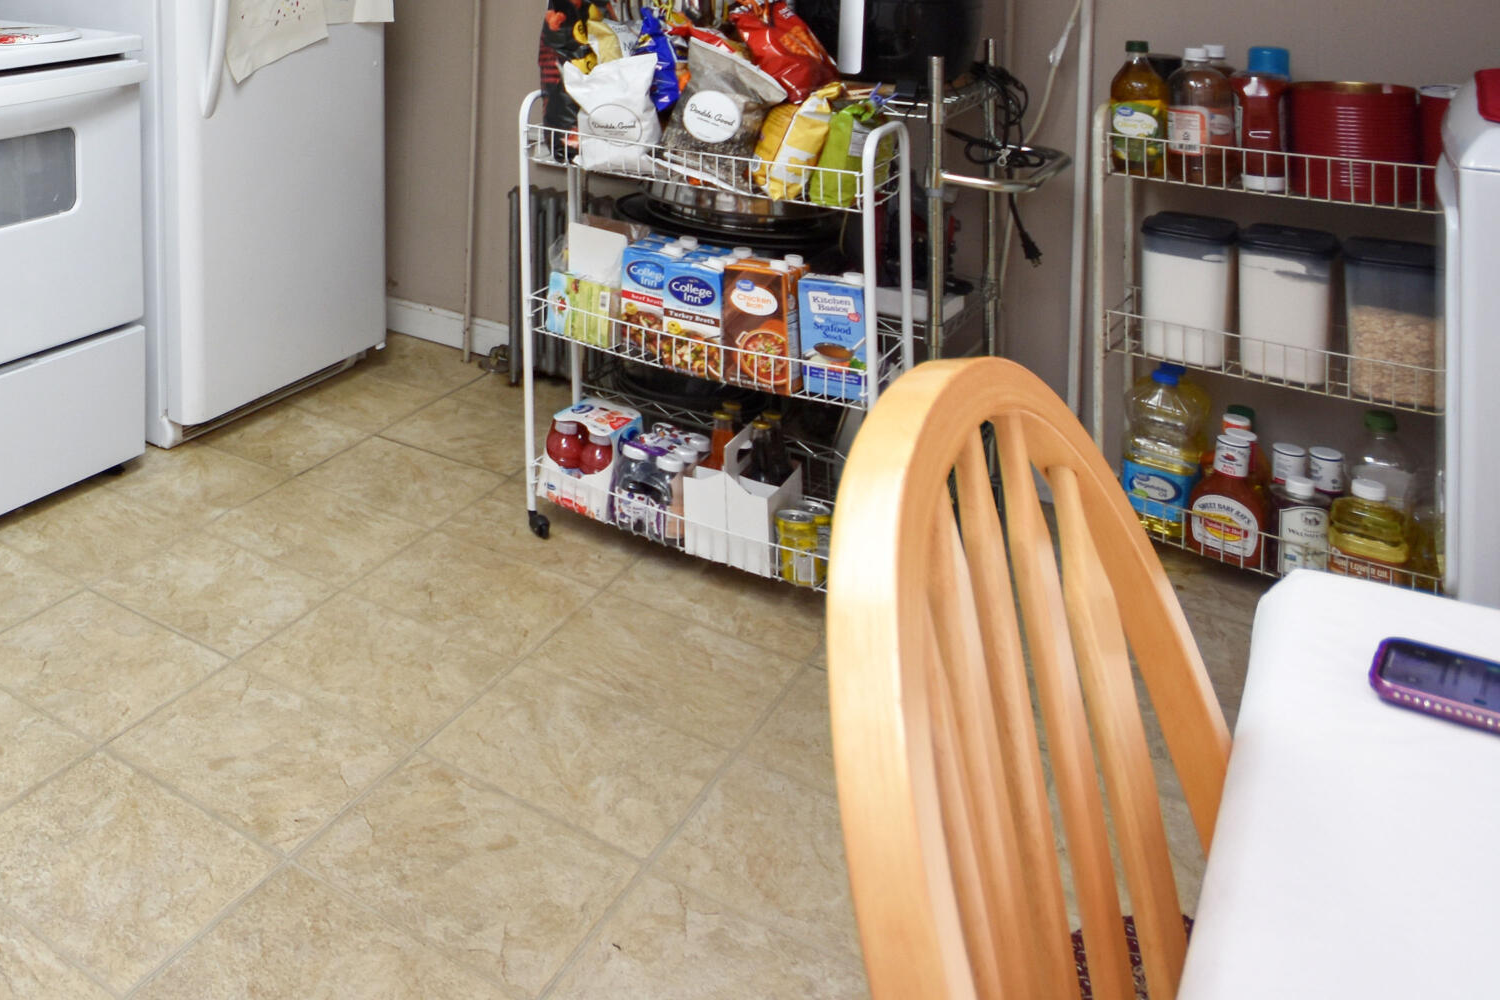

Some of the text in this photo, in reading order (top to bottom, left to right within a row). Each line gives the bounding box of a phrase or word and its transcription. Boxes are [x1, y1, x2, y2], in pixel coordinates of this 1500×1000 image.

[714, 112, 736, 127] Good
[640, 276, 658, 287] Inn
[671, 281, 713, 299] College
[683, 292, 702, 304] Inn
[812, 295, 852, 306] Kitchen
[817, 303, 850, 313] Basics
[812, 321, 852, 335] Seafood
[1217, 503, 1235, 515] BABY
